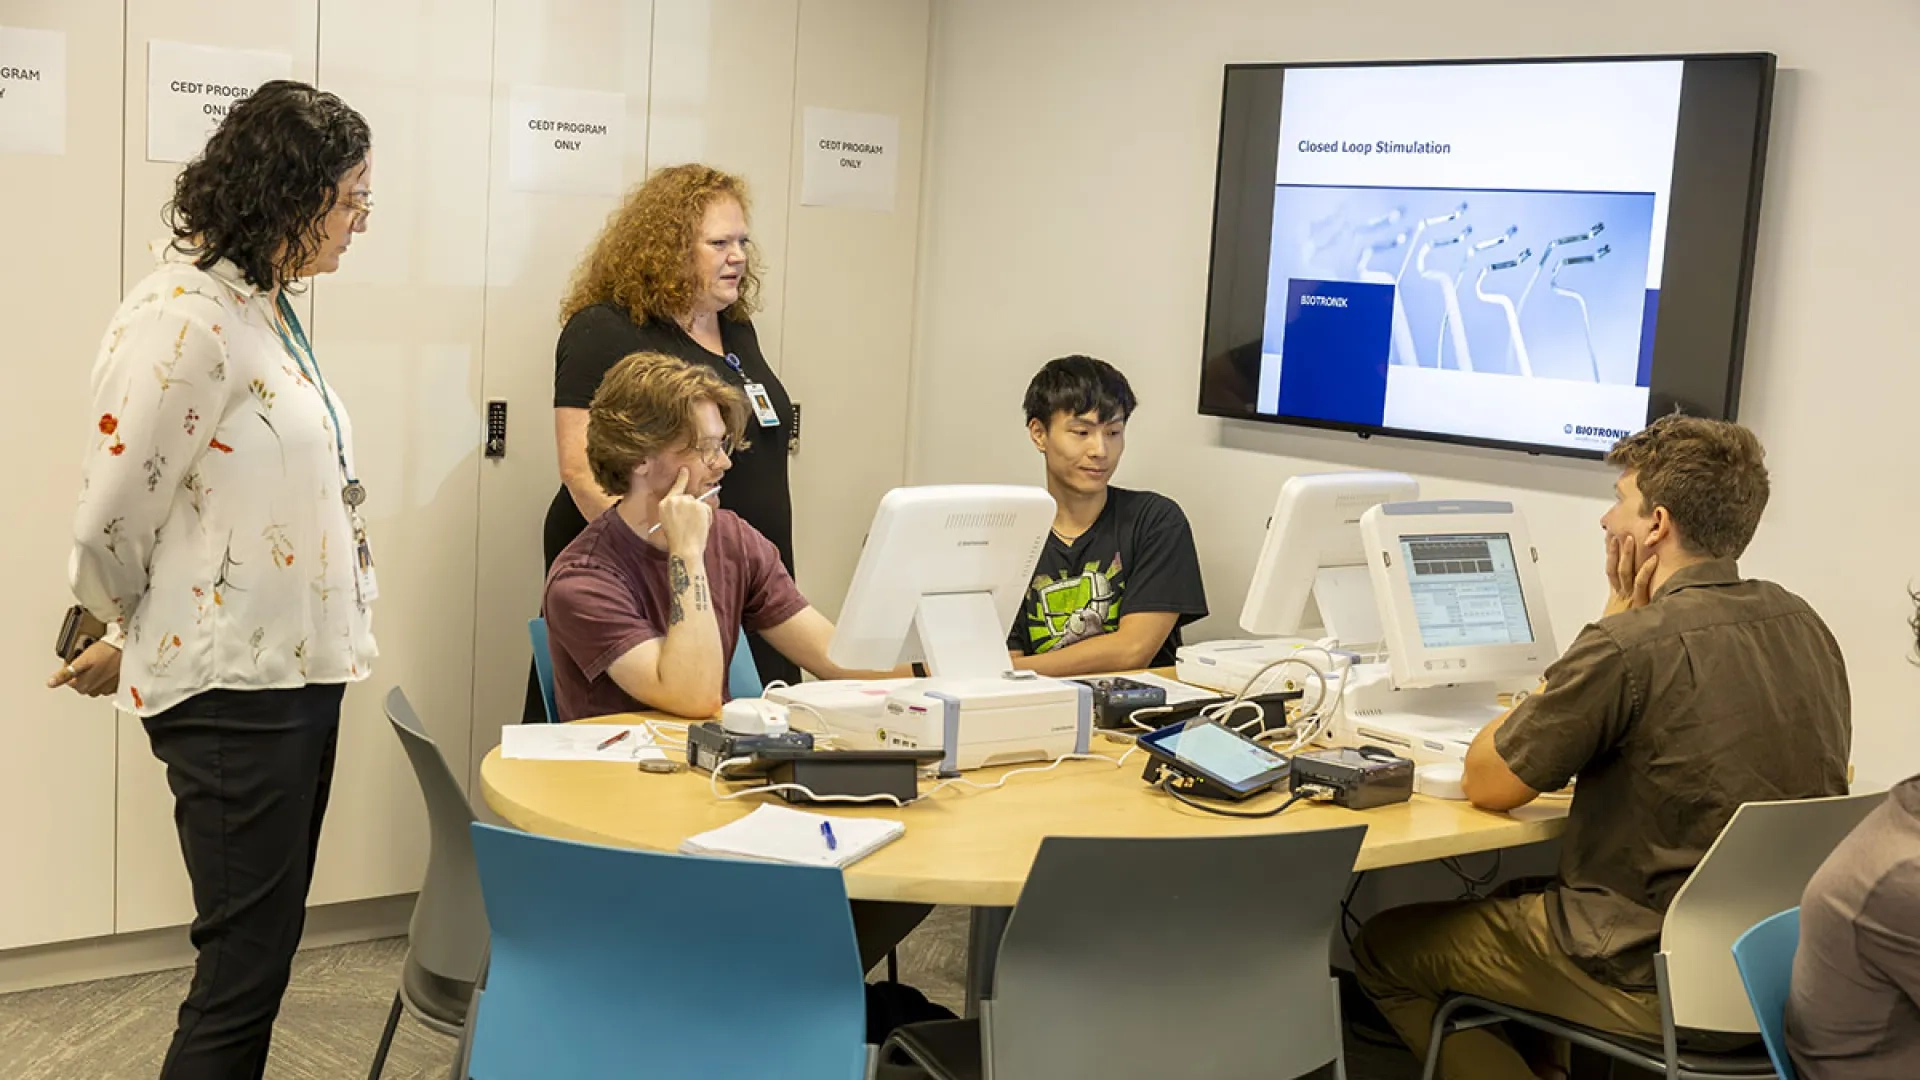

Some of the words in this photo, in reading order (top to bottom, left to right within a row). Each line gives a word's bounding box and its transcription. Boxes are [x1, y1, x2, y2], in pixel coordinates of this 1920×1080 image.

[0, 66, 41, 81] GRAM
[170, 80, 203, 94] CEDT
[205, 84, 258, 98] PROGRA
[202, 103, 229, 116] ONL
[528, 119, 555, 131] CEDT
[556, 121, 607, 135] PROGRAM
[554, 139, 581, 150] ONLY
[819, 139, 841, 150] CEDT
[842, 141, 882, 154] PROGRAM
[1298, 140, 1338, 153] Closed
[1341, 141, 1372, 155] Loop
[1375, 140, 1451, 154] Stimulation
[839, 158, 861, 169] ONLY
[1300, 294, 1348, 308] BIOTRONIK
